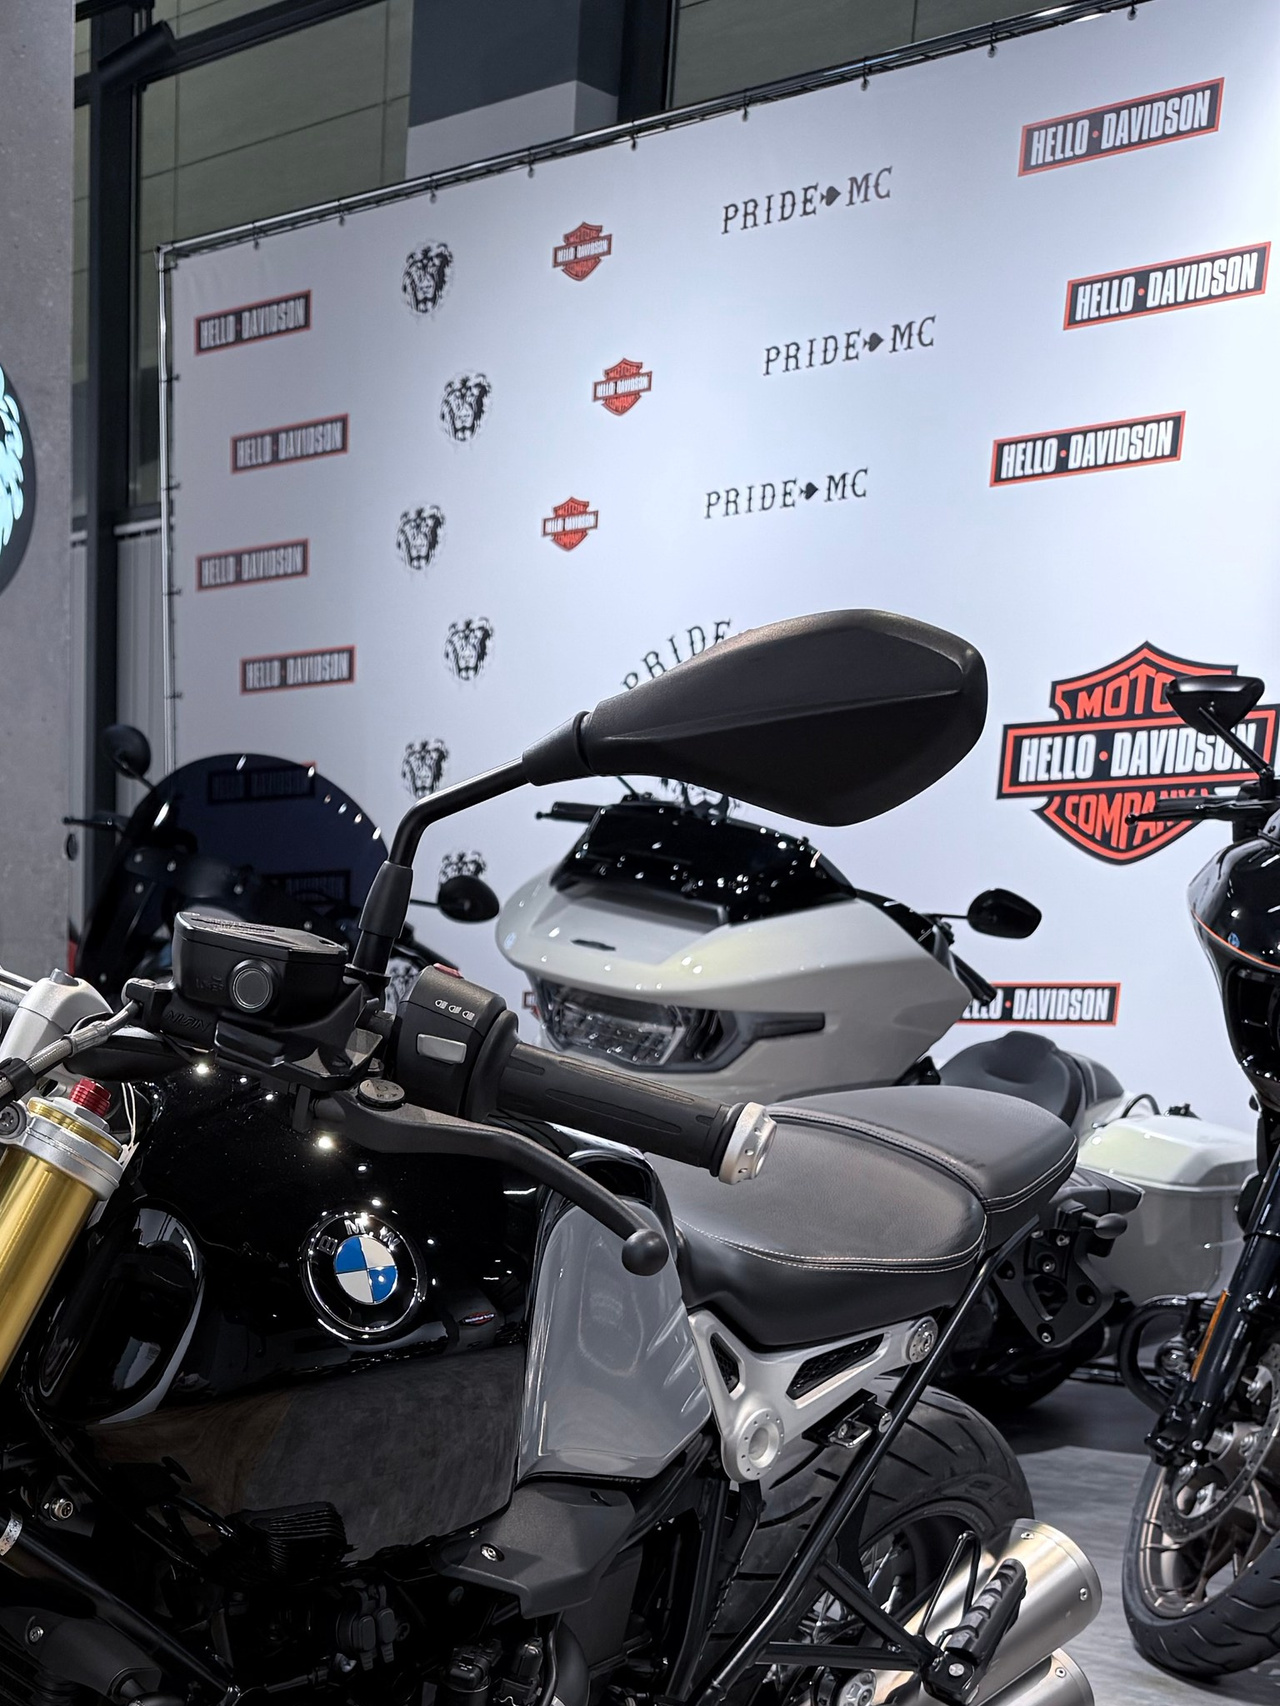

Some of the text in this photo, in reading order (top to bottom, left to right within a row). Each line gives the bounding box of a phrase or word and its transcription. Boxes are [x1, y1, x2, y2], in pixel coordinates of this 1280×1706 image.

[1031, 90, 1211, 166] HELLO DAVIDSON
[721, 167, 893, 234] PRIDE MC
[1076, 253, 1258, 321] HELLO DAVIDSON
[199, 297, 305, 349] HELLO DAVIDSON
[763, 316, 937, 376] PRIDE MC
[236, 421, 342, 469] HELLO DAVIDSON
[1001, 421, 1174, 479] HELLO DAVIDSON
[704, 468, 869, 519] PRIDE MC
[201, 546, 304, 586] HELLO DAVIDSON
[246, 652, 350, 691] HELLO DAVIDSON
[1076, 662, 1177, 720] MOTO
[1018, 734, 1097, 783] HELLO
[1110, 722, 1257, 777] DAVIDSON
[1012, 988, 1110, 1020] DAVIDSON
[318, 1217, 401, 1256] BMW
